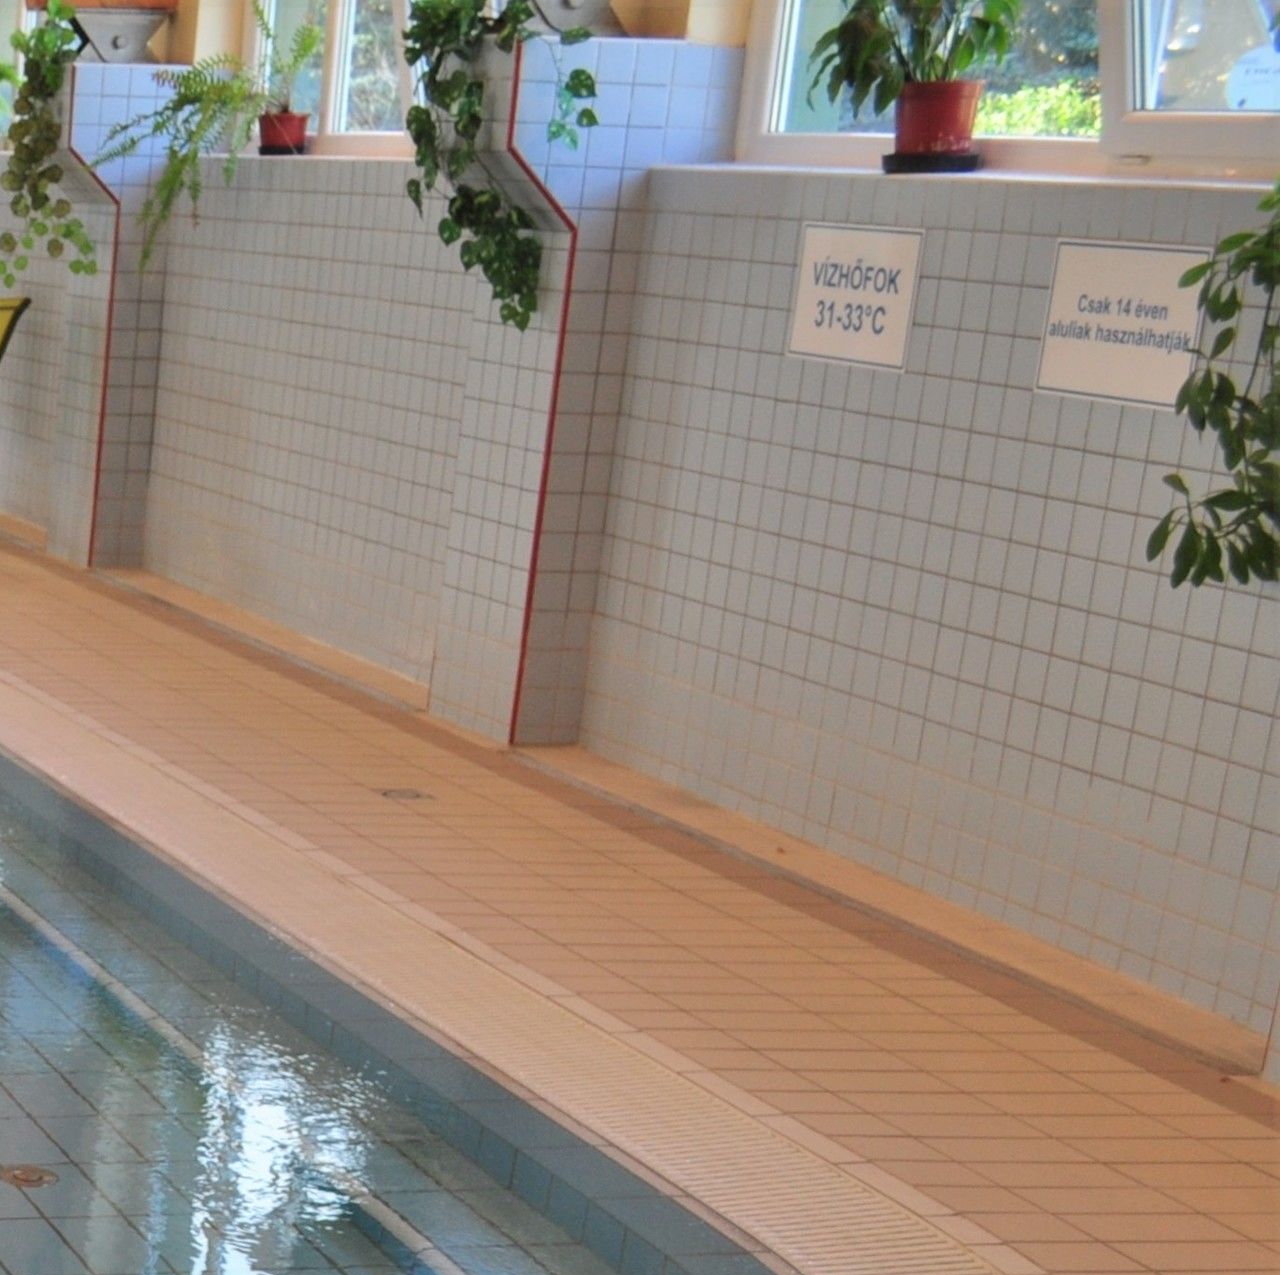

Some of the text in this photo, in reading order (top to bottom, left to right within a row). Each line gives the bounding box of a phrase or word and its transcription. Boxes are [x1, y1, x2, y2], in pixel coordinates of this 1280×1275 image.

[813, 255, 902, 295] VÍZHŐFOK
[814, 299, 887, 335] 31-33°C
[1077, 294, 1169, 321] Csak 14 éven
[1094, 323, 1191, 354] használhatják
